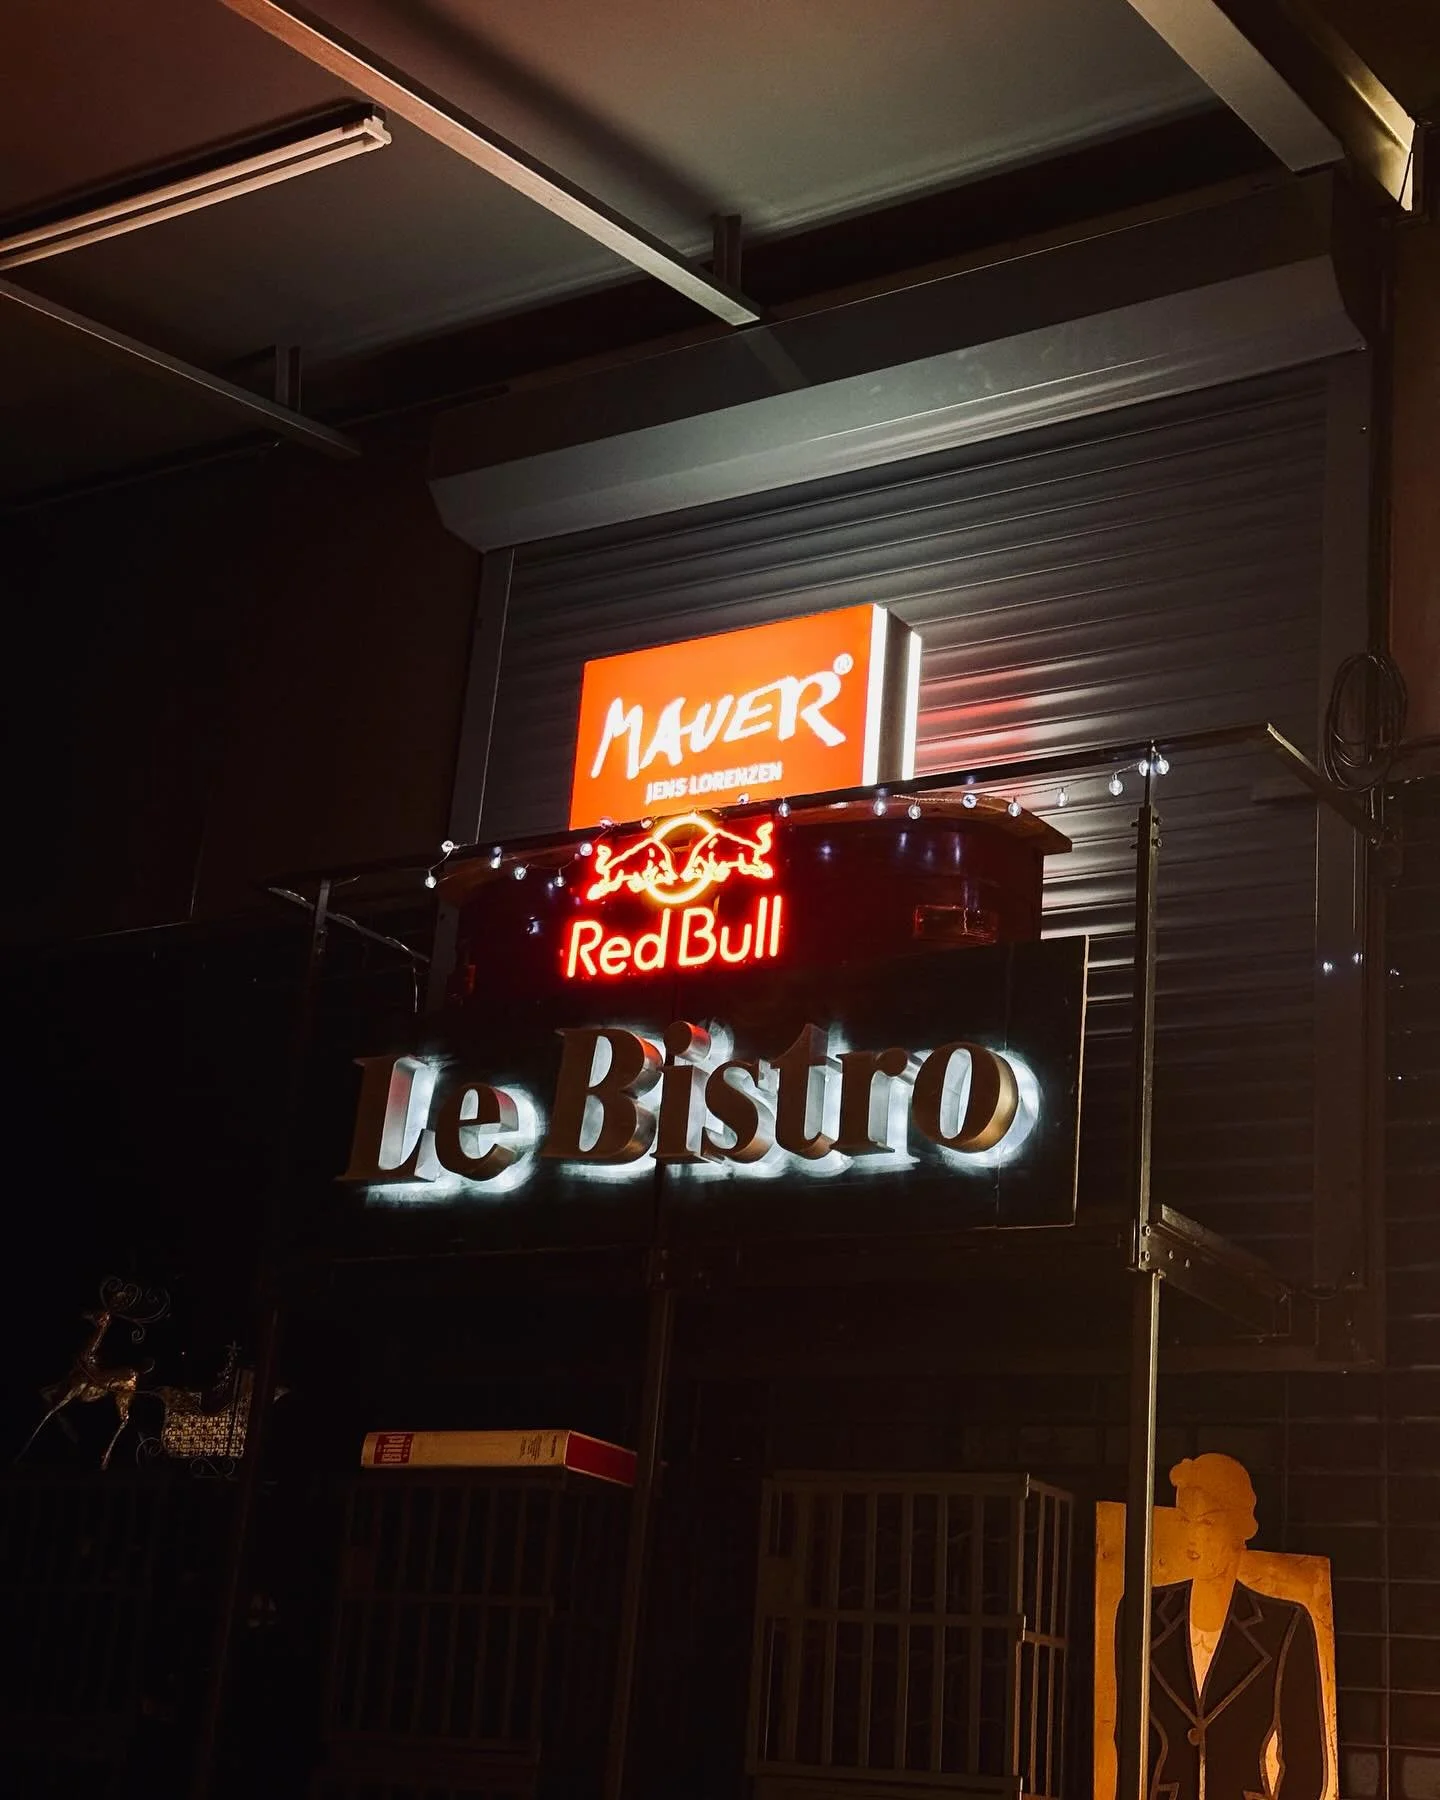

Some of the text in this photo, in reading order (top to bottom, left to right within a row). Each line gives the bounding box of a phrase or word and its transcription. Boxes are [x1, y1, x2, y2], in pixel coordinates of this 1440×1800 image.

[645, 761, 783, 805] JENS LORENZEN
[567, 895, 783, 978] Red Bull
[337, 1019, 1019, 1184] Le Bistro
